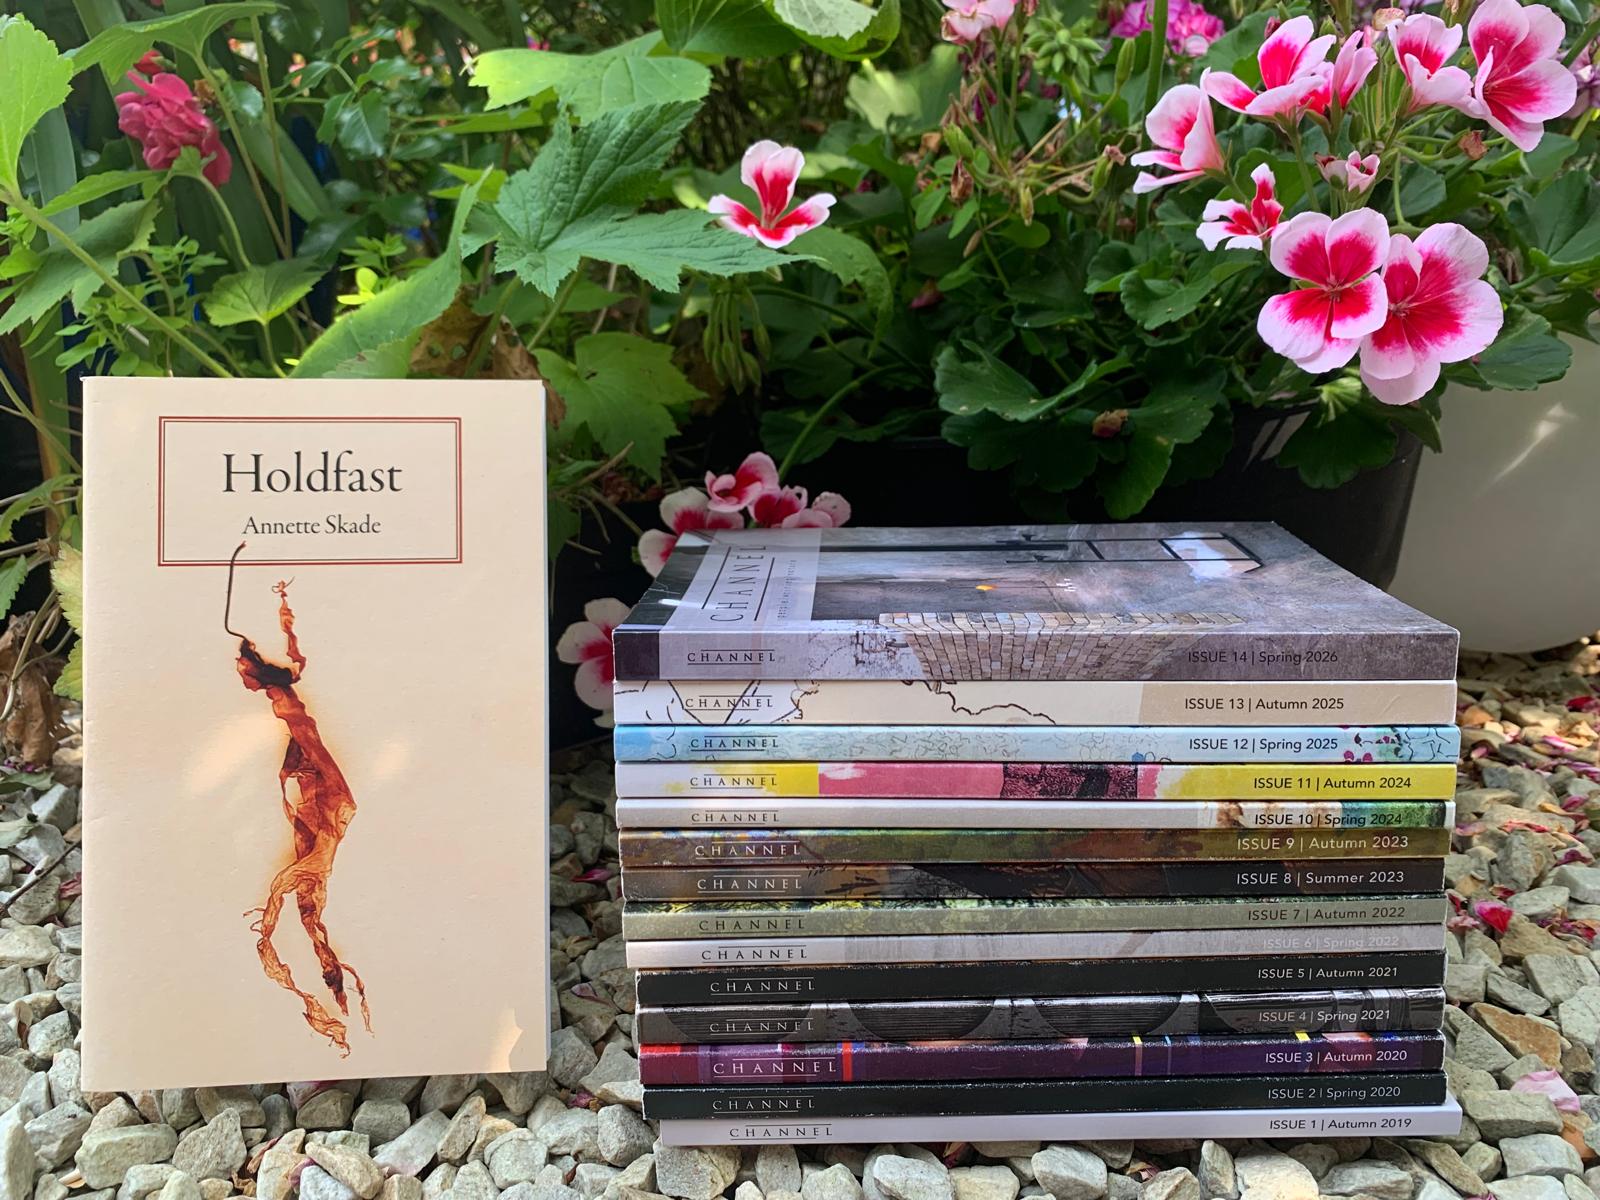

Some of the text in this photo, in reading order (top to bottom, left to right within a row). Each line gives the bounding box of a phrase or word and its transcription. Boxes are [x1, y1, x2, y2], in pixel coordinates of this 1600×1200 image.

[222, 450, 402, 493] Holdfast
[242, 514, 381, 534] Annette Skade
[710, 546, 766, 622] CHANNEL
[687, 651, 775, 662] CHANNEL
[1188, 652, 1227, 663] ISSUE
[1233, 652, 1247, 663] 14
[1259, 651, 1302, 667] Spring
[1306, 652, 1338, 663] 2026
[685, 697, 773, 708] CHANNEL
[1185, 698, 1223, 710] ISSUE
[1229, 698, 1244, 710] 13
[1256, 698, 1307, 710] Autumn
[1312, 698, 1344, 710] 2025
[691, 738, 778, 749] CHANNEL
[1189, 739, 1227, 750] ISSUE
[1233, 738, 1248, 750] 12
[1260, 738, 1303, 754] Spring
[1307, 738, 1338, 750] 2025
[690, 776, 777, 786] CHANNEL
[1254, 778, 1292, 789] ISSUE
[1299, 777, 1311, 789] 11
[1324, 777, 1375, 789] Autumn
[1380, 777, 1411, 788] 2024
[692, 813, 779, 823] CHANNEL
[1255, 814, 1293, 825] ISSUE
[1299, 814, 1313, 825] 10
[1324, 814, 1366, 827] Spring
[1370, 813, 1402, 824] 2024
[1237, 838, 1280, 850] ISSUE
[1287, 838, 1295, 849] 9
[1309, 837, 1366, 849] Autumn
[1372, 836, 1408, 848] 2023
[695, 844, 800, 857] CHANNEL
[697, 878, 802, 890] CHANNEL
[1237, 873, 1278, 885] ISSUE
[1284, 872, 1292, 884] 8
[1306, 872, 1363, 884] Summer
[1369, 871, 1404, 883] 2023
[1248, 909, 1286, 920] ISSUE
[1292, 909, 1300, 920] 7
[1314, 908, 1366, 919] Autumn
[1372, 907, 1405, 918] 2022
[699, 918, 805, 931] CHANNEL
[1263, 938, 1299, 949] ISSUE
[1304, 937, 1312, 949] 6
[1323, 936, 1364, 951] Spring
[1368, 935, 1399, 947] 2022
[702, 948, 807, 960] CHANNEL
[1258, 968, 1293, 979] ISSUE
[1298, 968, 1305, 978] 5
[1316, 967, 1364, 978] Autumn
[1369, 966, 1398, 977] 2021
[710, 980, 815, 993] CHANNEL
[1259, 1011, 1294, 1022] ISSUE
[1299, 1011, 1306, 1021] 4
[1317, 1010, 1357, 1023] Spring
[1361, 1009, 1390, 1020] 2021
[709, 1021, 813, 1033] CHANNEL
[1265, 1052, 1301, 1063] ISSUE
[1305, 1052, 1313, 1062] 3
[1324, 1051, 1372, 1062] Autumn
[1376, 1050, 1407, 1061] 2020
[714, 1061, 836, 1074] CHANNEL
[1268, 1088, 1303, 1099] ISSUE
[1308, 1088, 1315, 1098] 2
[1326, 1087, 1366, 1101] Spring
[1370, 1086, 1400, 1097] 2020
[713, 1099, 815, 1111] CHANNEL
[1269, 1119, 1306, 1130] ISSUE
[1310, 1119, 1315, 1129] 1
[1328, 1119, 1377, 1129] Autumn
[1381, 1117, 1411, 1128] 2019
[729, 1127, 833, 1137] CHANNEL
